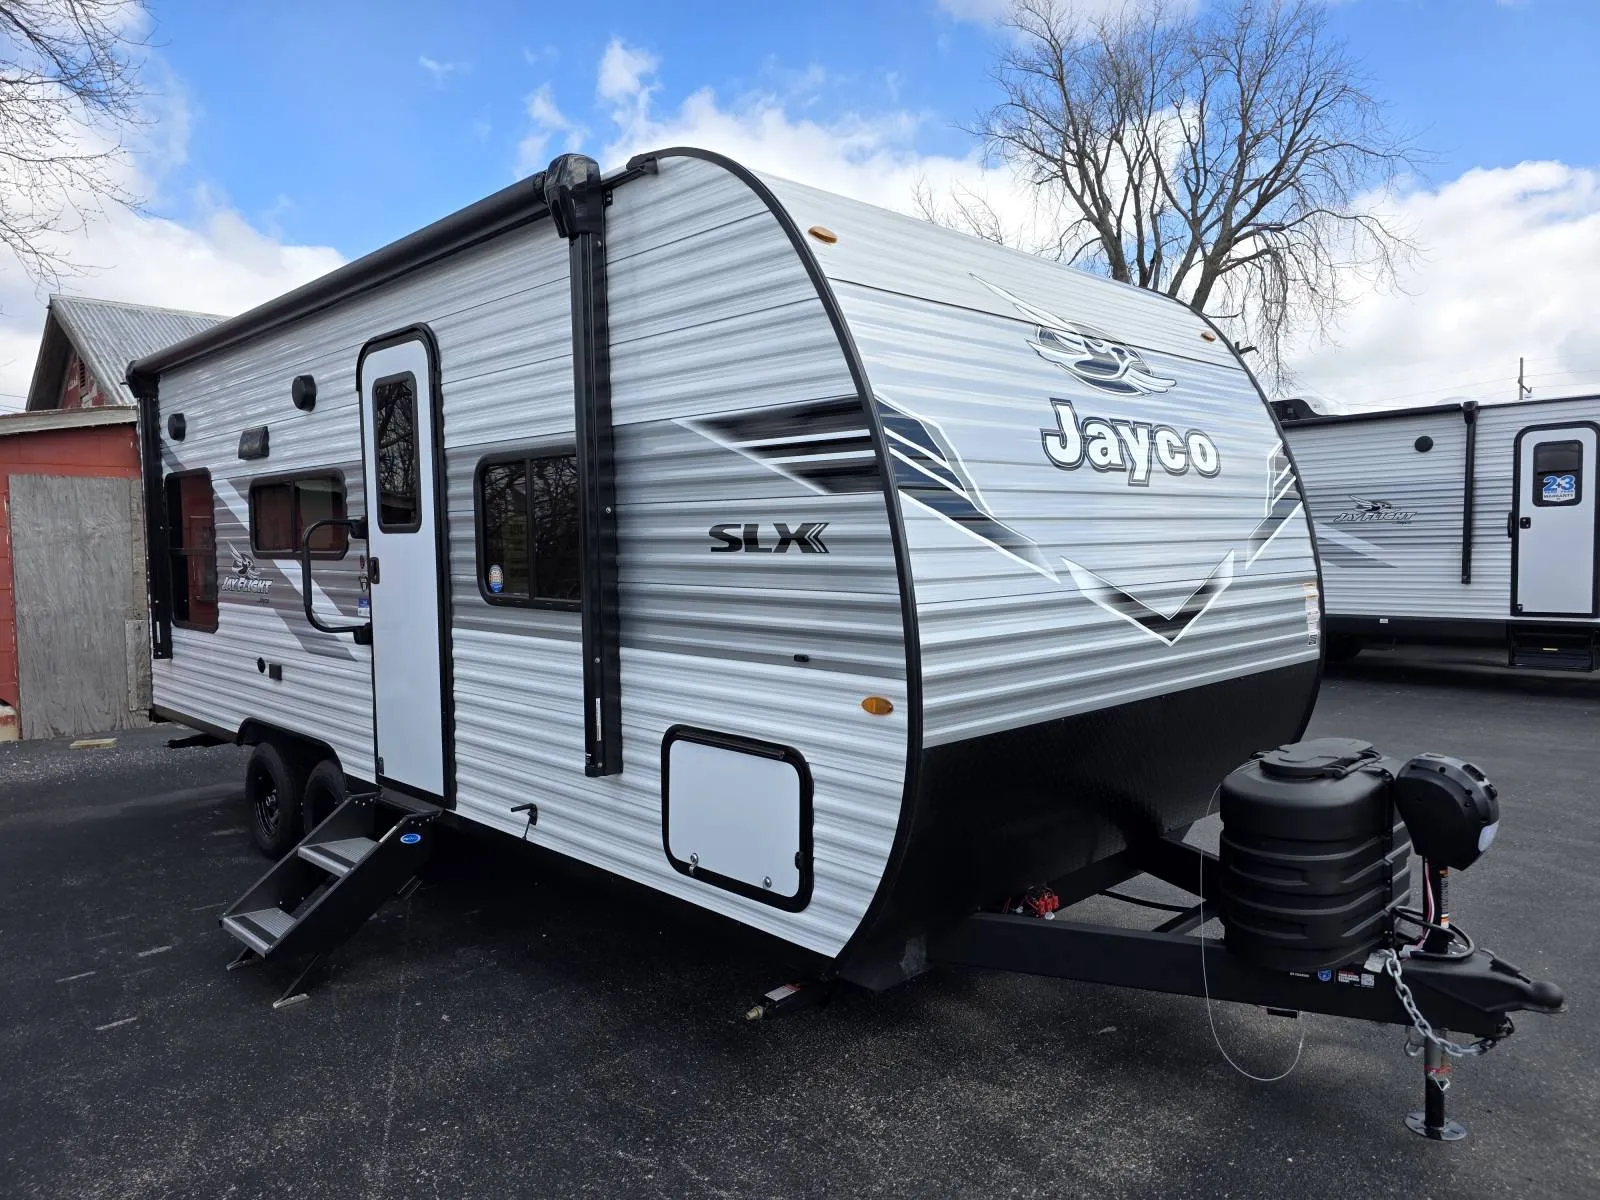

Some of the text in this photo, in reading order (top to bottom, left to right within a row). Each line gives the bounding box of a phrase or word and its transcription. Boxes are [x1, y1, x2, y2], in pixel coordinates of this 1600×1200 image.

[1040, 397, 1221, 487] Jayco
[1333, 511, 1417, 523] JAY FLIGHT
[708, 522, 830, 554] SLX
[221, 576, 273, 594] JAY FLIGHT
